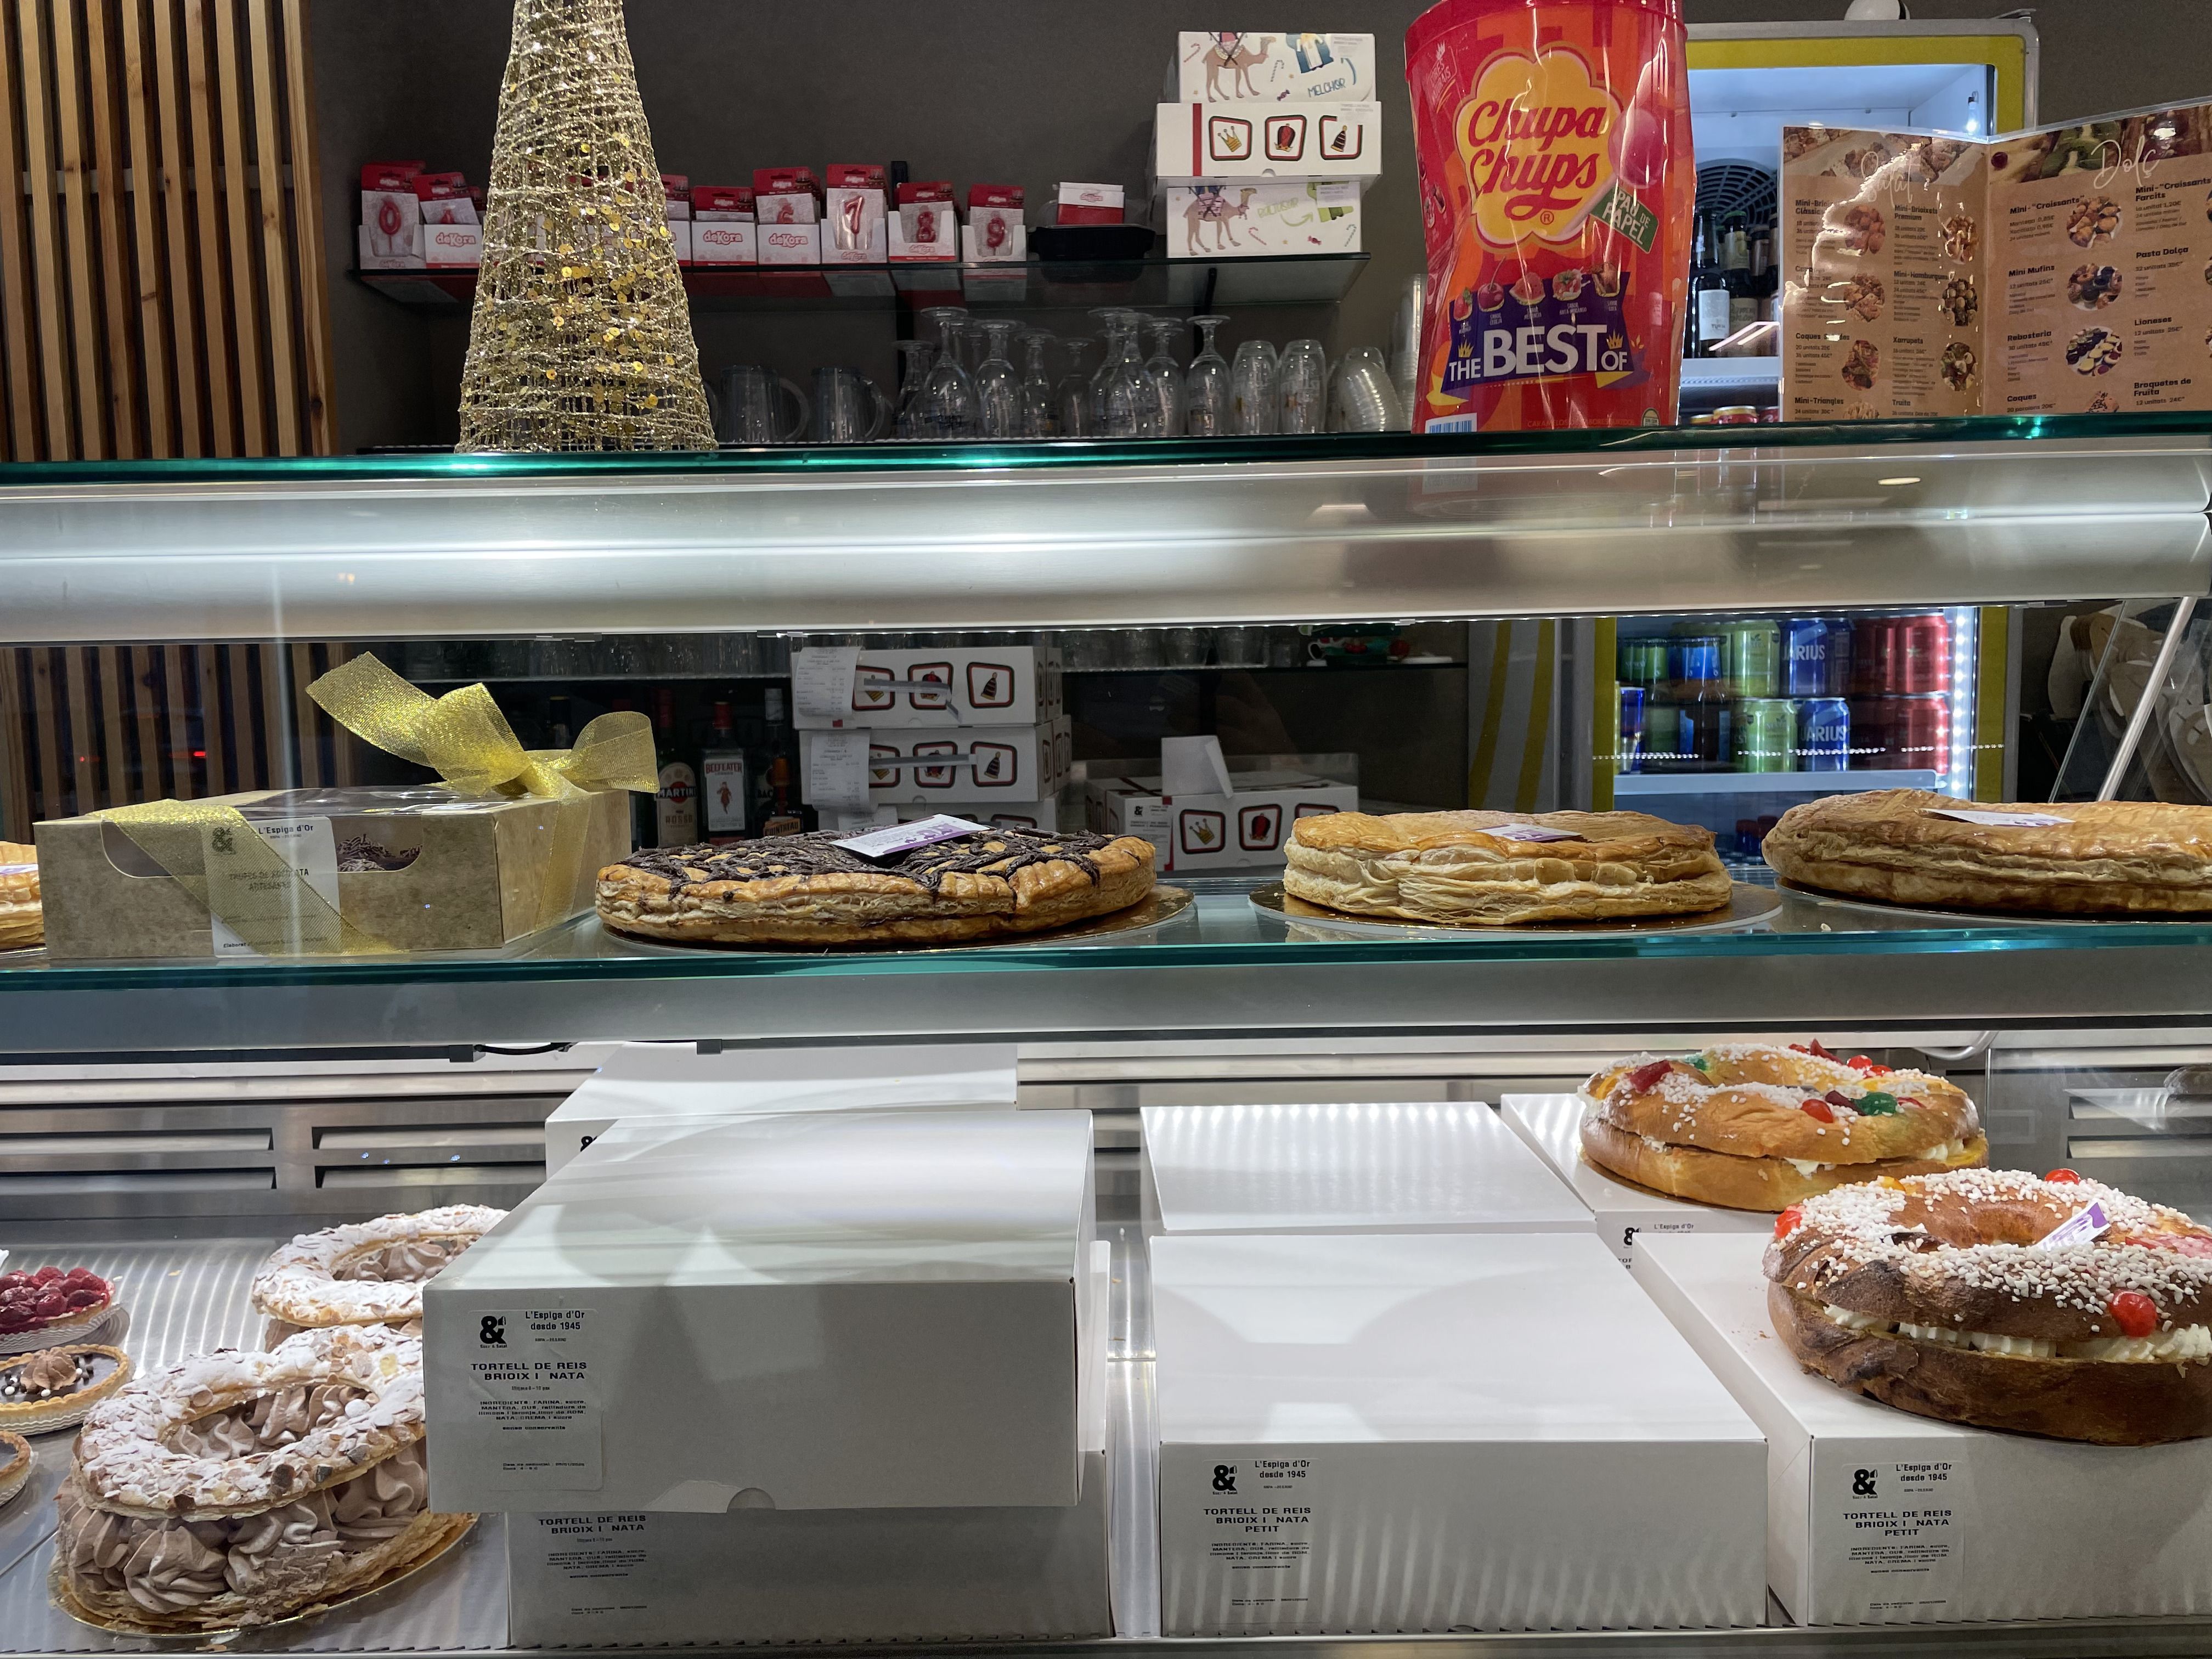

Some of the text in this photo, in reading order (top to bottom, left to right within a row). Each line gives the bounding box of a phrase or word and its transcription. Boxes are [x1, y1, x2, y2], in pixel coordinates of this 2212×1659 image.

[1468, 99, 1605, 151] Chupa
[1470, 149, 1601, 214] Chups
[2135, 192, 2166, 202] Farcits
[1615, 190, 1651, 228] PAU DE
[1602, 201, 1643, 245] PAPEL
[2163, 247, 2189, 256] Dolça
[2008, 264, 2055, 277] Mini Mufins
[2134, 317, 2172, 326] Lioneses
[2007, 330, 2052, 341] Rebosteria
[1893, 337, 1923, 345] Xarrupets
[1449, 357, 1481, 381] THE
[1483, 323, 1610, 379] BEST
[1601, 350, 1628, 372] OF
[2134, 388, 2160, 397] Fruita
[1795, 396, 1844, 405] Mini-Triangles
[2007, 394, 2037, 402] Coques
[1784, 645, 1825, 661] ARIUS
[706, 763, 742, 774] BEEFEATER
[665, 814, 693, 824] ROSSO
[525, 1310, 585, 1321] L'Espiga d'Or
[531, 1322, 581, 1330] desde 1945
[470, 1362, 587, 1371] TORTELL DE REIS
[1255, 1460, 1290, 1469] L'Espiga
[1896, 1464, 1931, 1472] L'Espiga
[1928, 1473, 1947, 1481] 1945
[538, 1517, 593, 1525] TORTELL
[551, 1526, 594, 1534] BRIOIX
